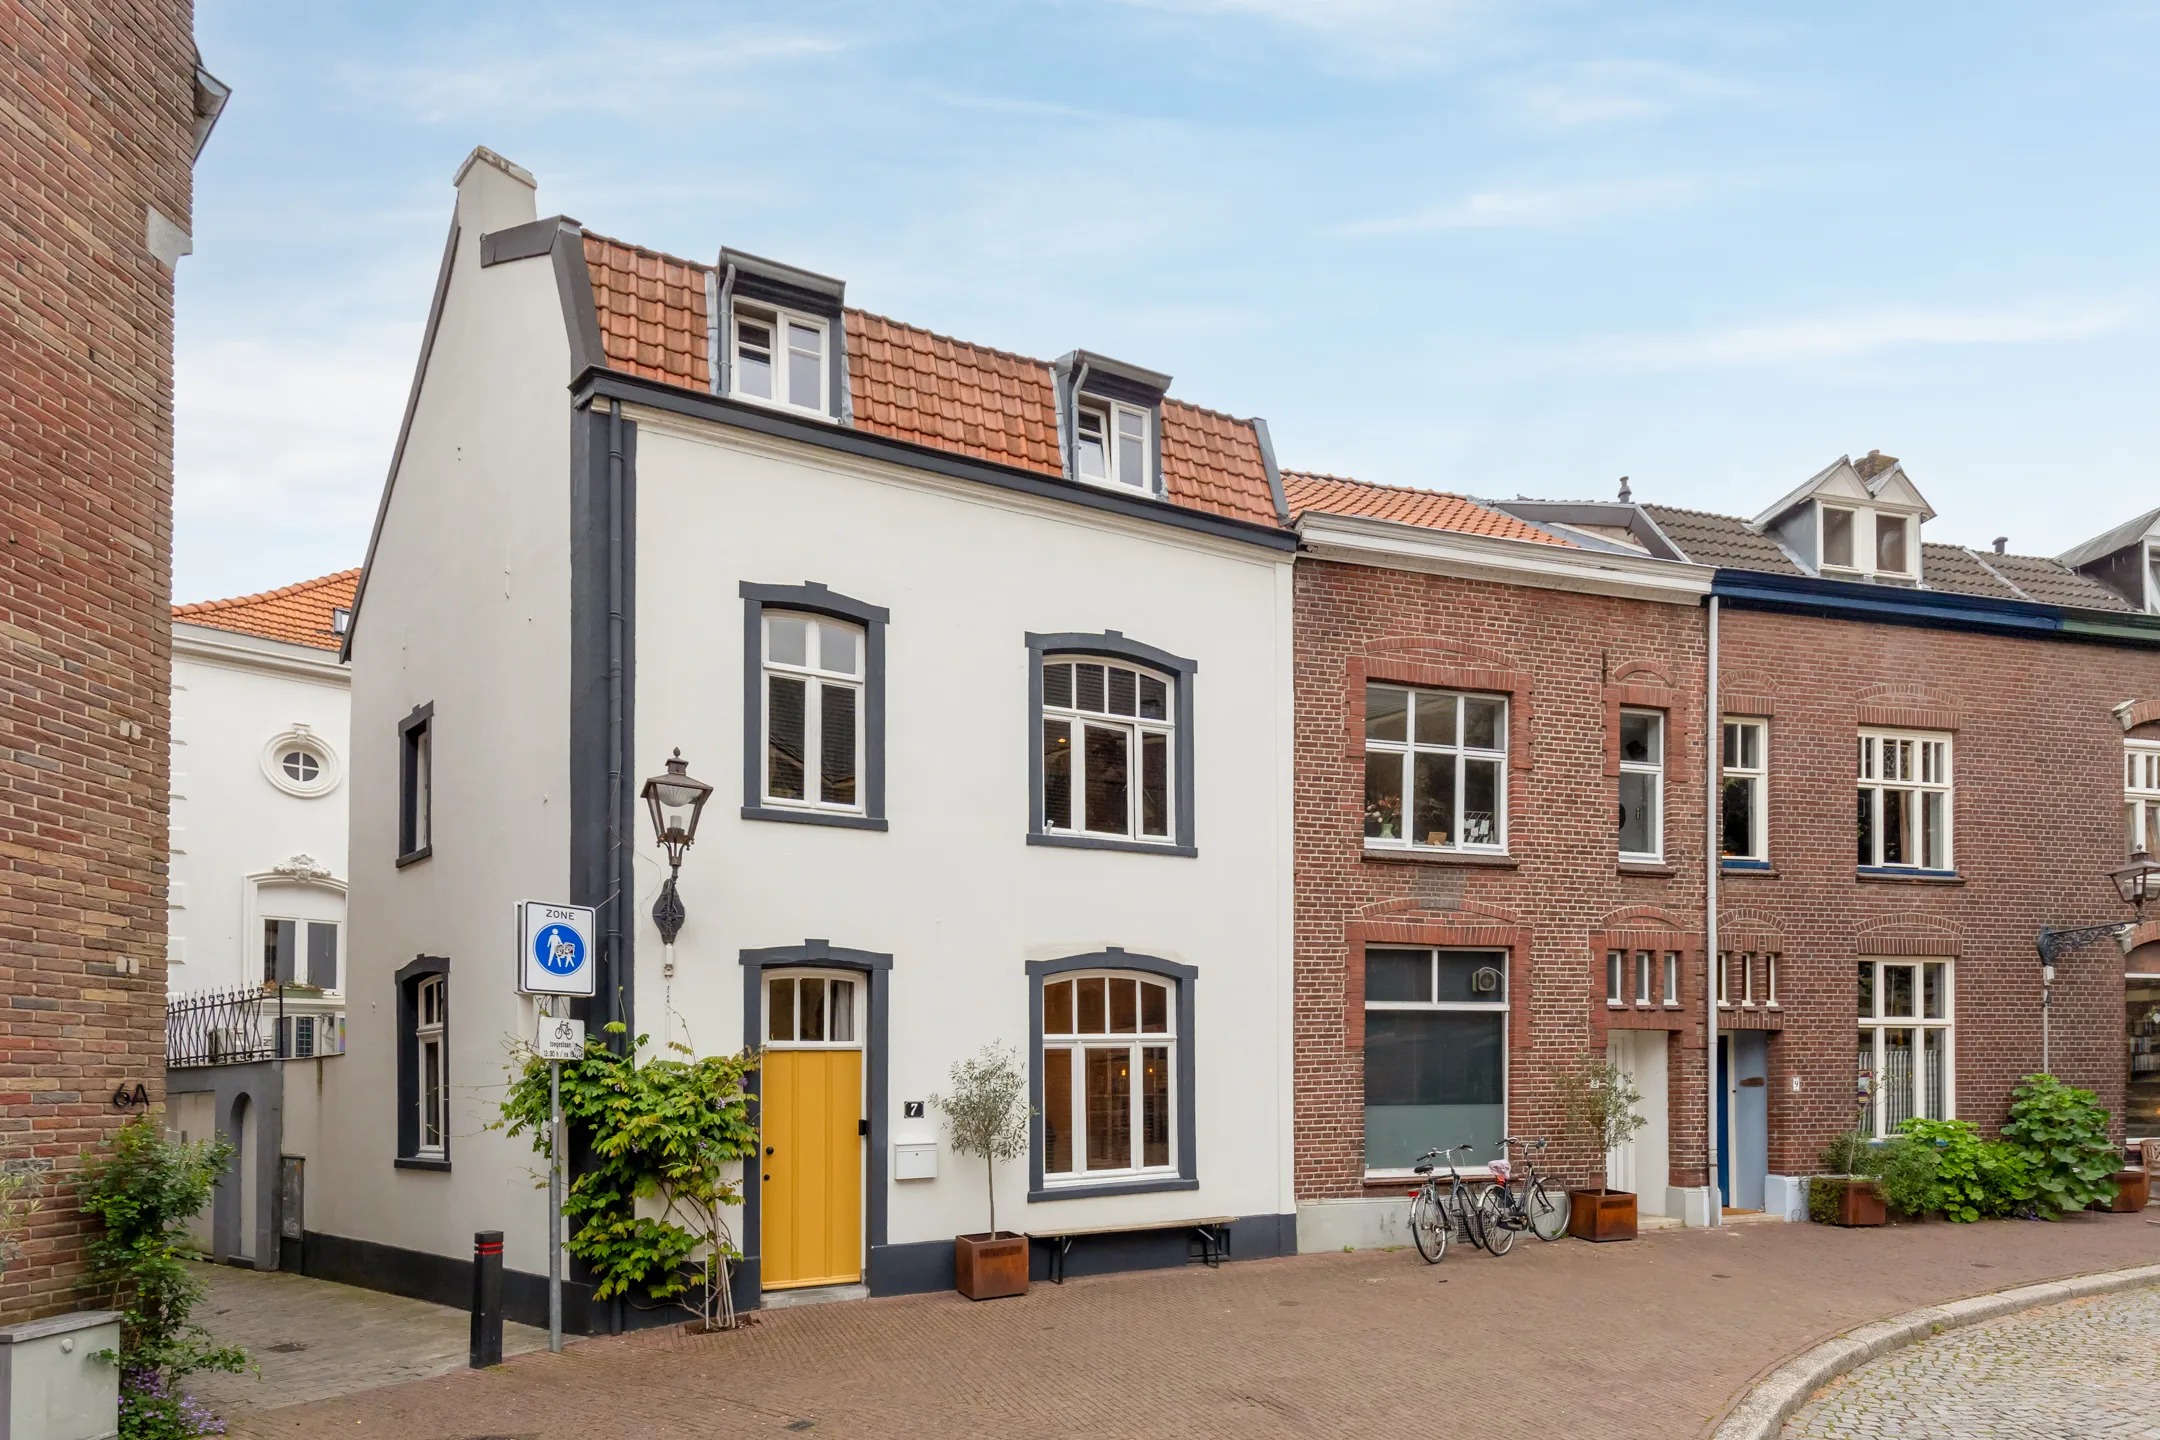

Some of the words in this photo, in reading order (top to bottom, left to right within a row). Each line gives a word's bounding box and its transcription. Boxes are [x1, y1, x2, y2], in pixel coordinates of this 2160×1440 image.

[546, 909, 575, 920] ZONE
[113, 1083, 150, 1106] 6A
[910, 1103, 918, 1116] 7
